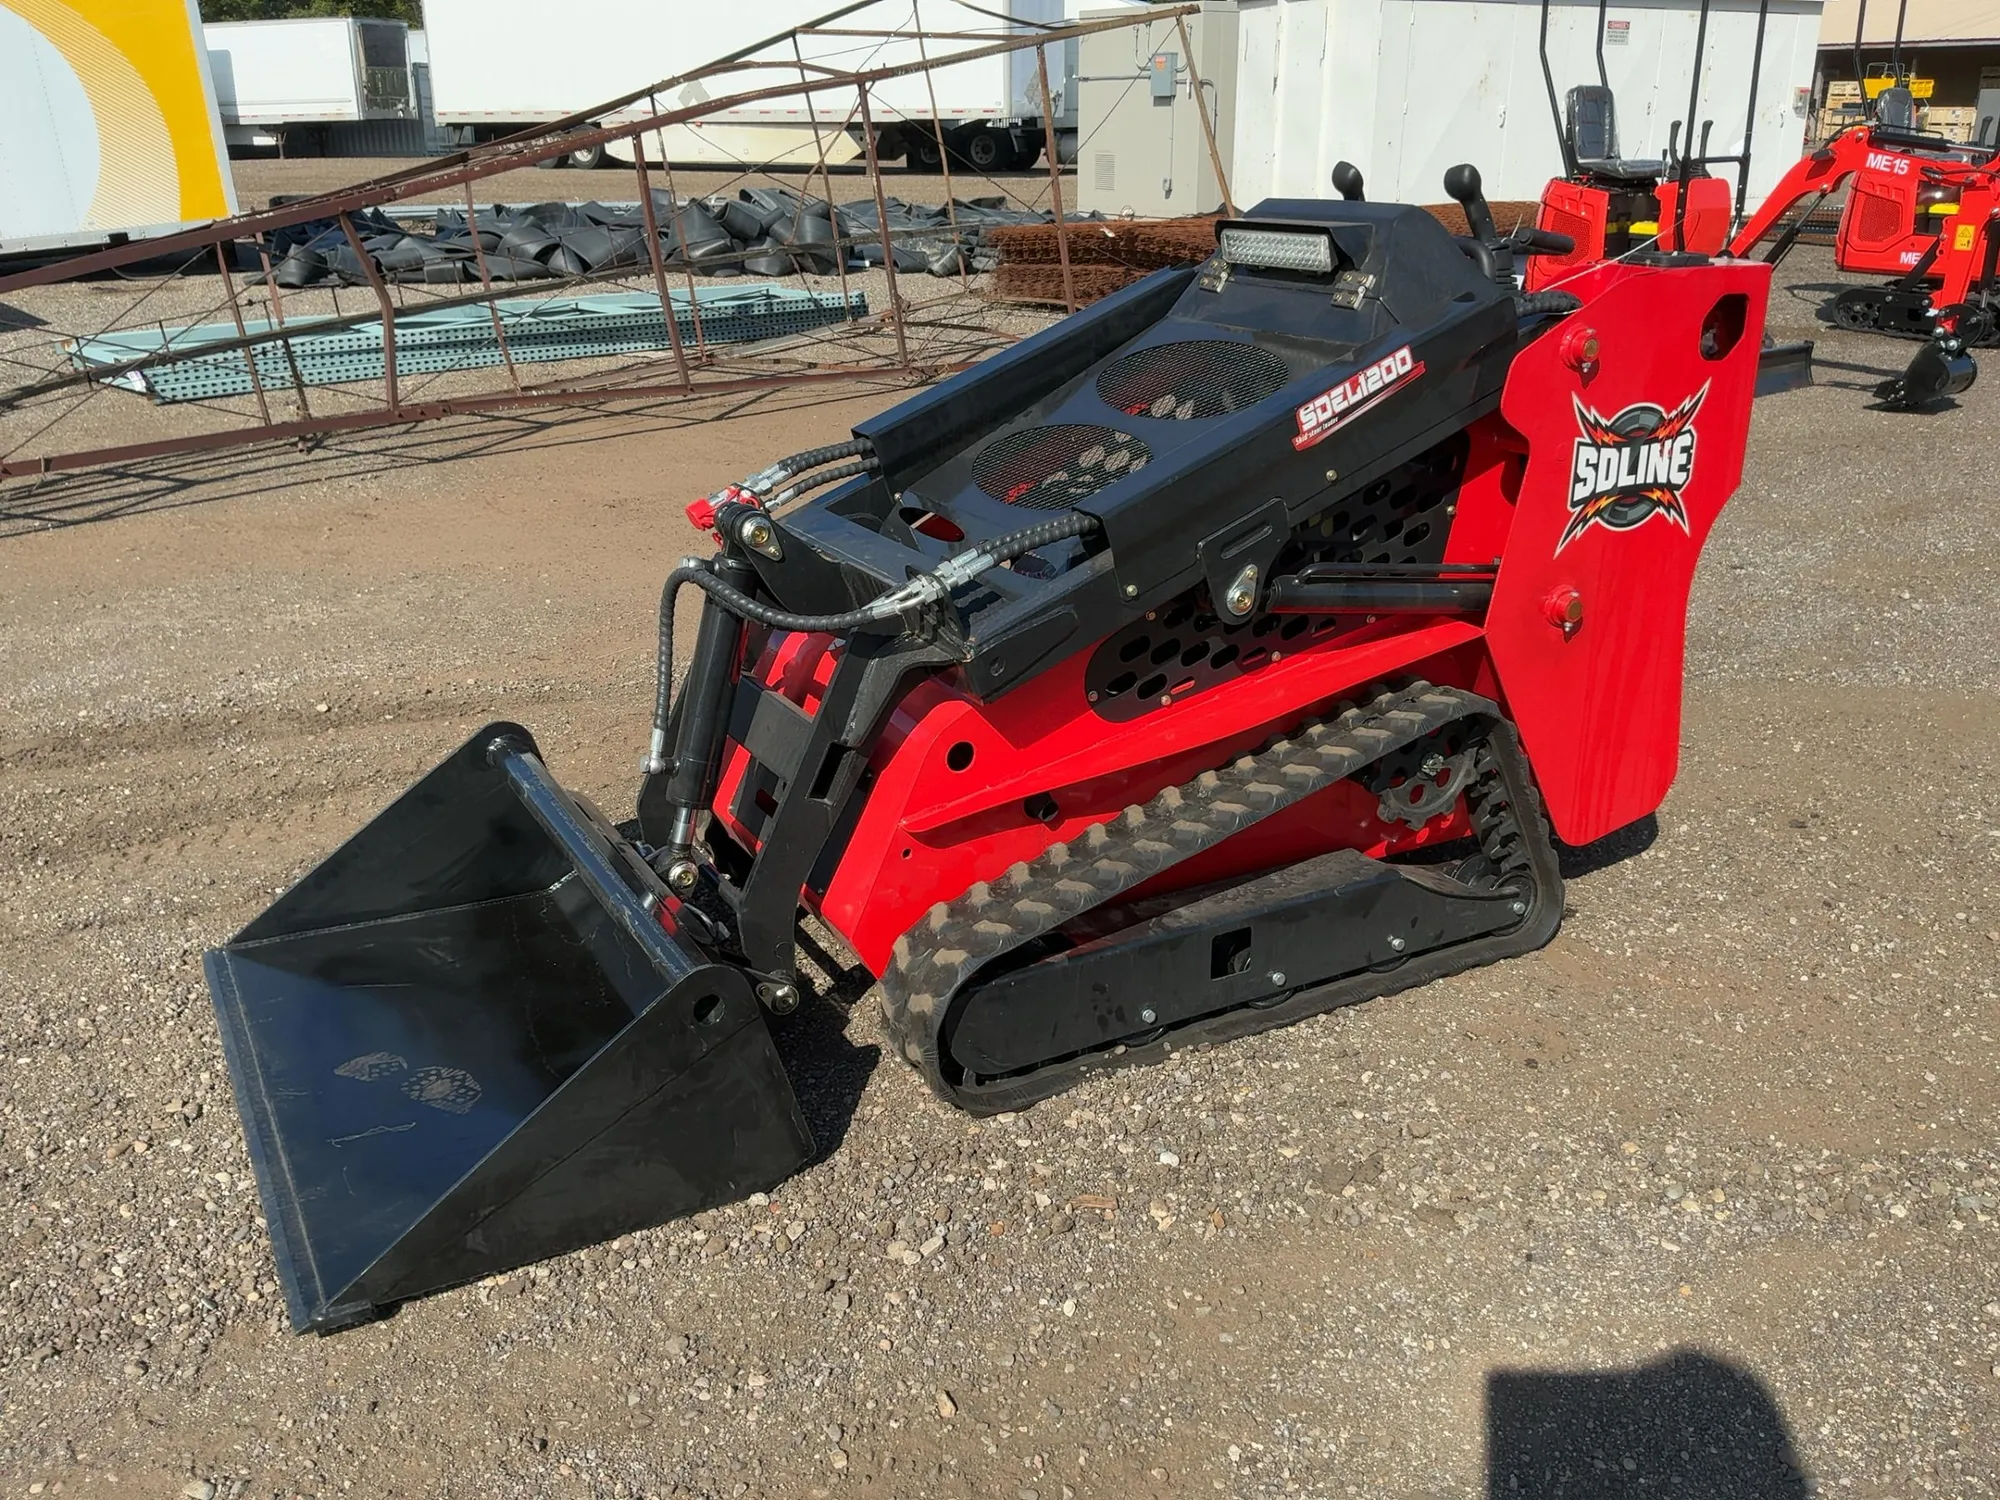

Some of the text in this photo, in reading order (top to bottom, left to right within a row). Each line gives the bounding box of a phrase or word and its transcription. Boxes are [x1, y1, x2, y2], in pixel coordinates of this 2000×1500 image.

[1866, 153, 1909, 175] ME15
[1900, 251, 1922, 265] ME
[1573, 433, 1693, 502] SDLINE
